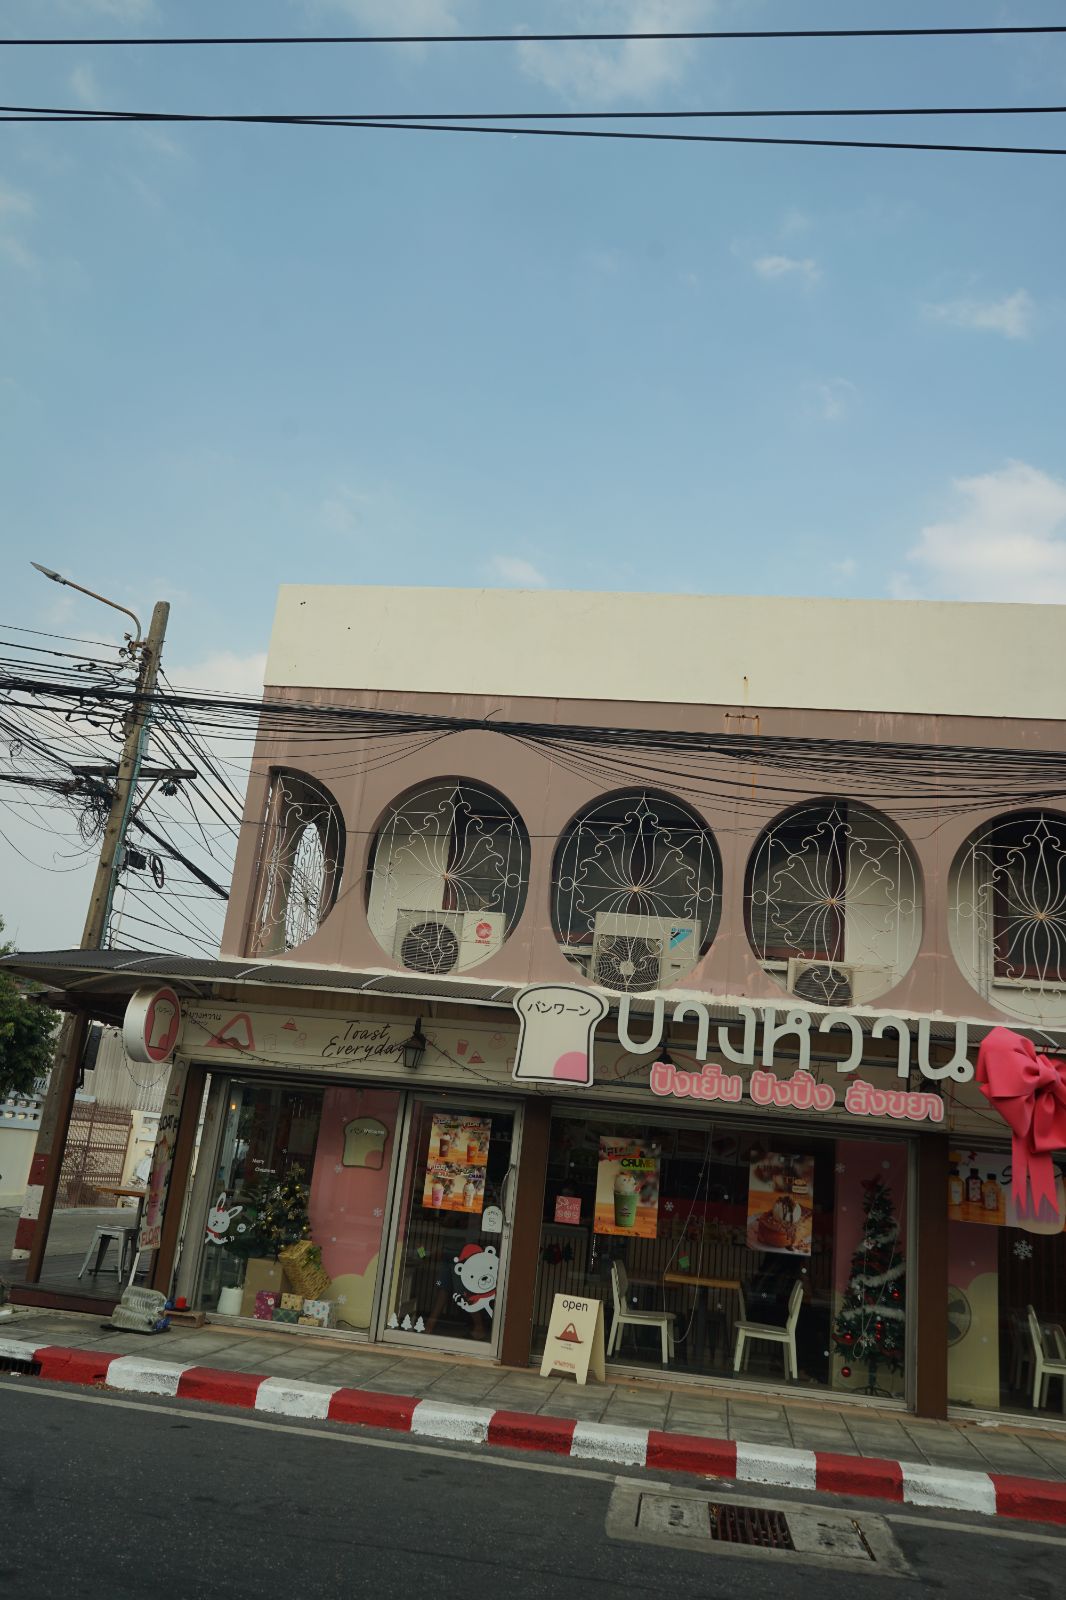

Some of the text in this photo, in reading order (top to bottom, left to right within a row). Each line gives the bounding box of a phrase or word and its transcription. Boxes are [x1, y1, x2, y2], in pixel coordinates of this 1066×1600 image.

[527, 1000, 591, 1017] バンワーン
[343, 1019, 392, 1041] Toast
[617, 993, 975, 1082] บางหวาน
[321, 1035, 406, 1063] Everyday
[651, 1064, 941, 1121] ปังเย็น ปังปิ้ง สังขยา
[562, 1299, 588, 1312] open
